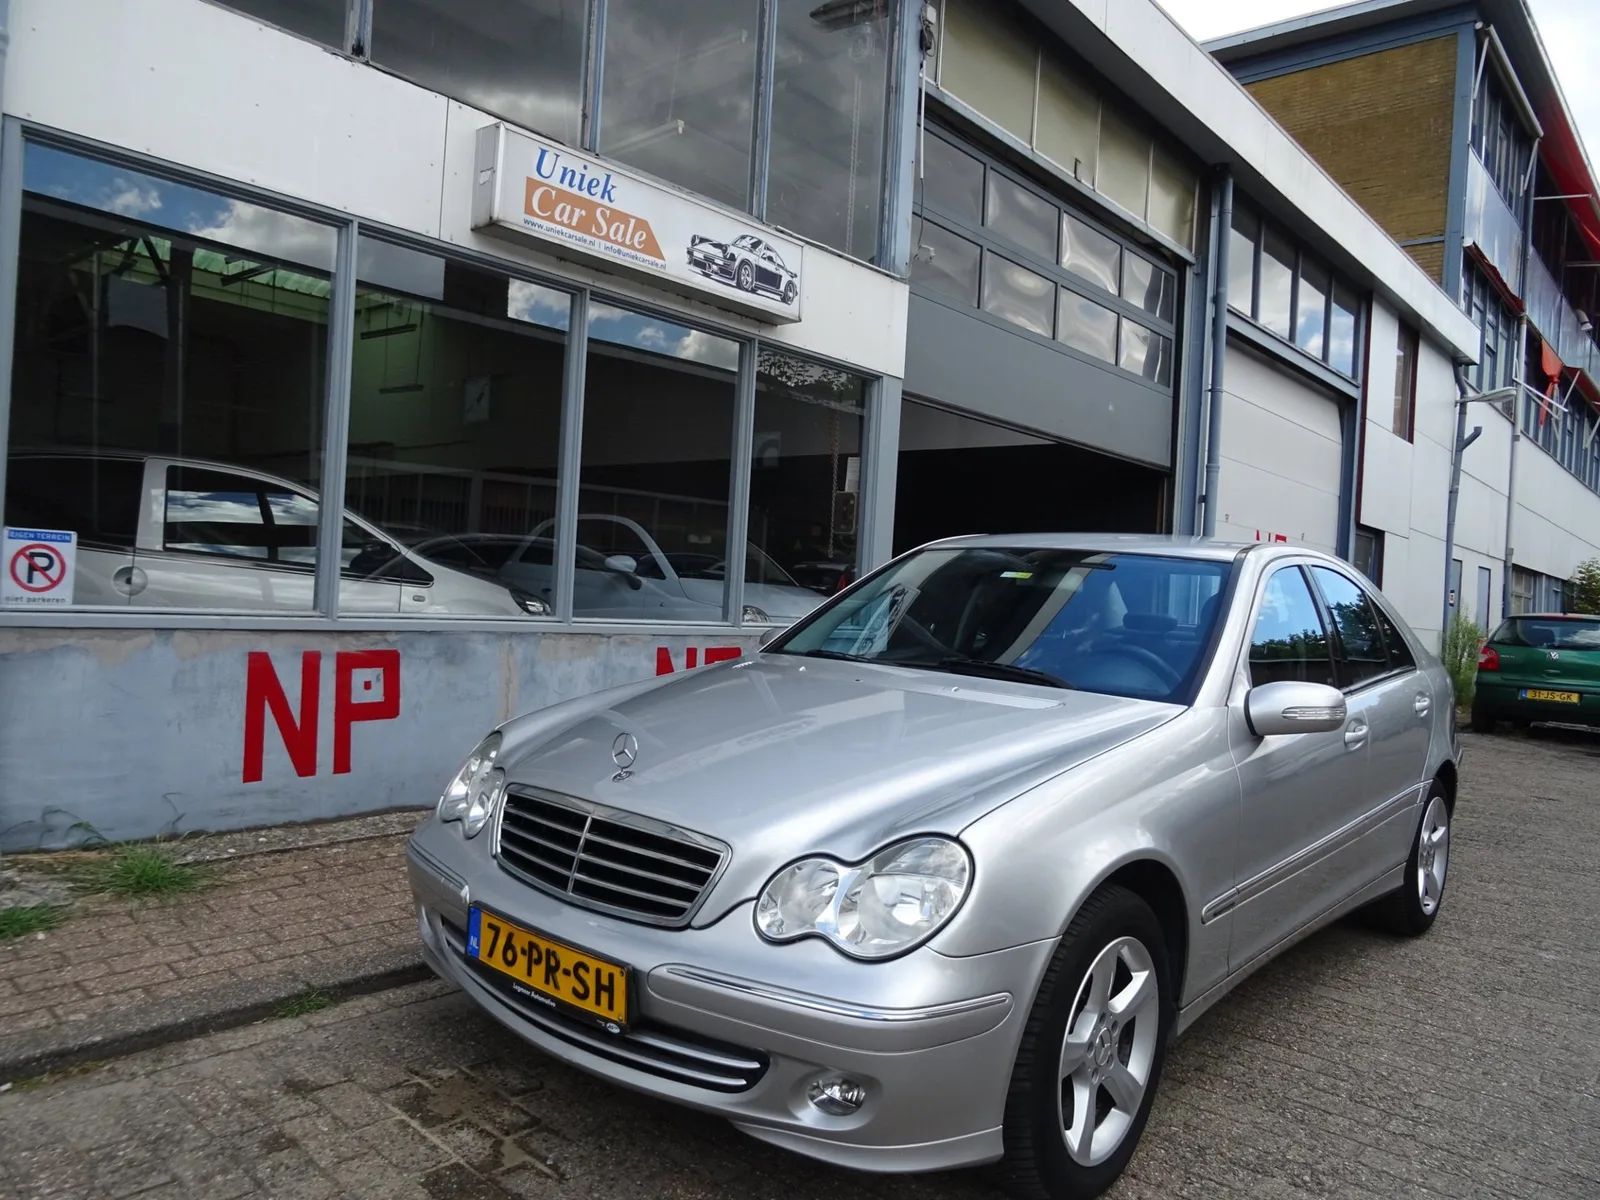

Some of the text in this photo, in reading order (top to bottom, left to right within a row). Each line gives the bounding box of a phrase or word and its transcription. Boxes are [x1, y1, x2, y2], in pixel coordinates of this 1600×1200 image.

[535, 146, 617, 203] Uniek
[523, 217, 596, 247] www.uniekcarsale.nl
[603, 244, 667, 271] info@uniekcarsale.nl
[531, 186, 647, 249] Car Sale
[242, 649, 401, 783] NP
[1531, 690, 1573, 701] 31-JS-GK
[487, 922, 615, 1012] 76-PR-SH
